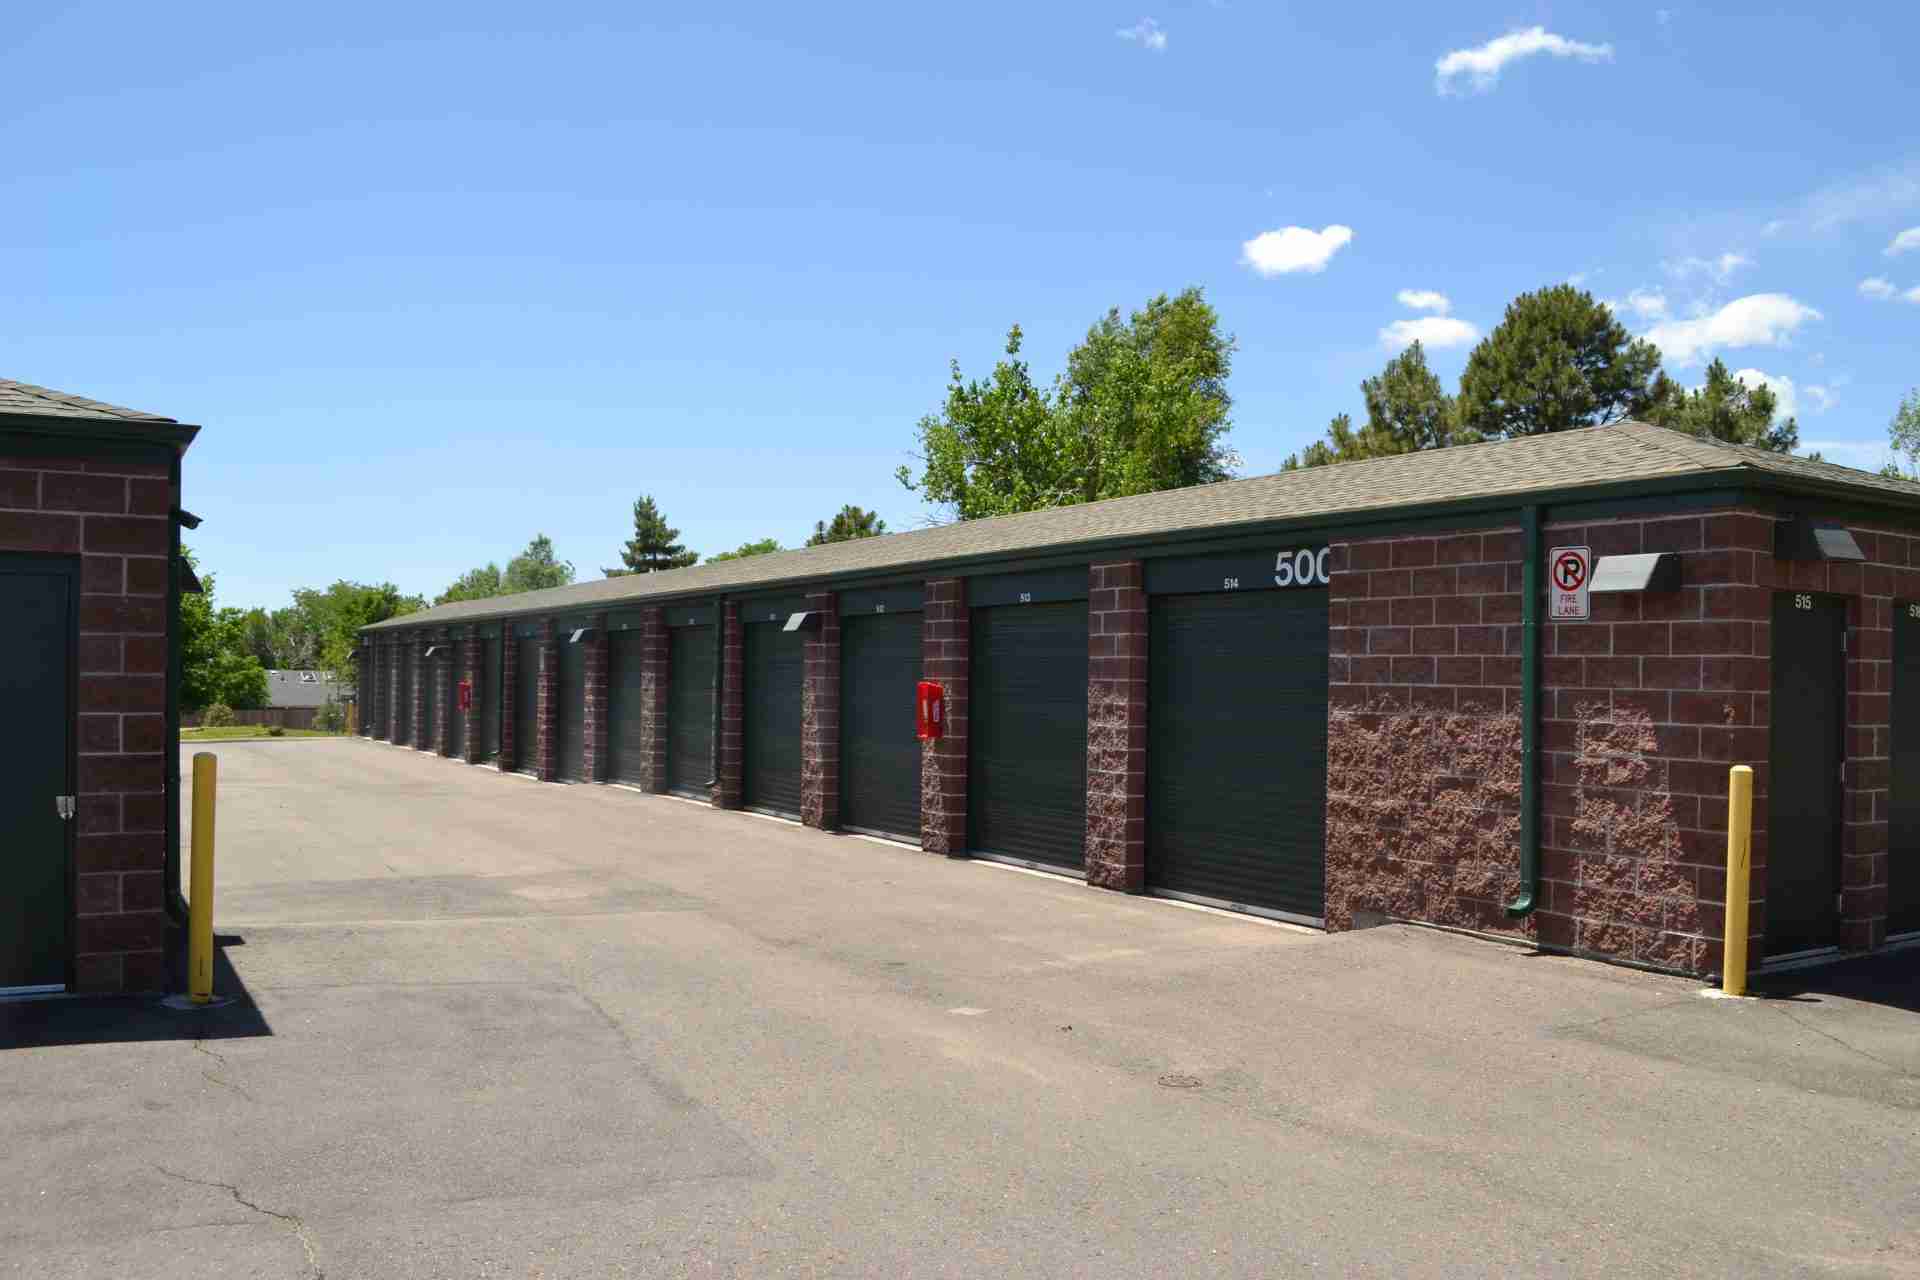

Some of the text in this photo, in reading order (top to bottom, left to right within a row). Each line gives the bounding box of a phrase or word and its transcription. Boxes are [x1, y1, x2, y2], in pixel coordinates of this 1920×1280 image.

[1224, 577, 1239, 589] 514
[1560, 594, 1577, 605] FIRE
[1794, 594, 1812, 609] 515
[1558, 606, 1582, 616] LANE
